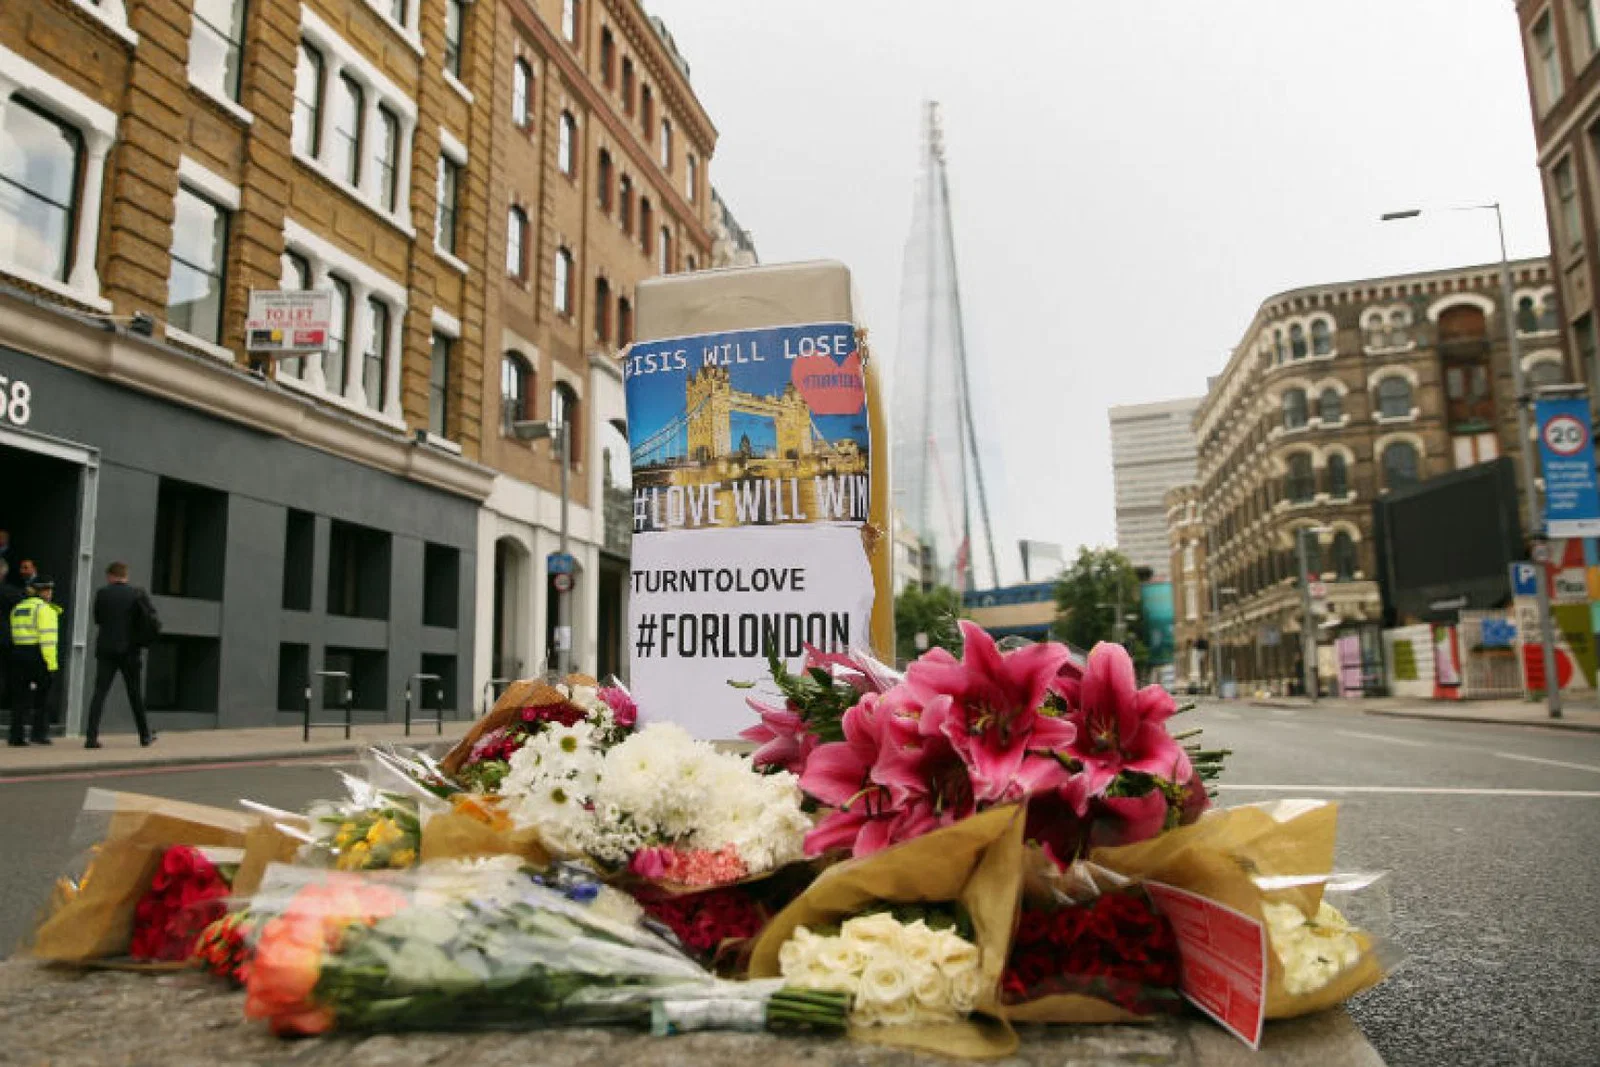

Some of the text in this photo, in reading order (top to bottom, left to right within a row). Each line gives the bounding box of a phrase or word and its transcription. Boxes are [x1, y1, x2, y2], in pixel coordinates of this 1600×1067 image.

[266, 307, 285, 320] TO
[704, 341, 765, 367] WILL
[784, 335, 848, 361] LOSE
[1549, 426, 1582, 444] 20
[633, 474, 868, 530] #LOVE WILL WIN
[632, 567, 806, 593] TURNTOLOVE
[635, 611, 850, 659] #FORLONDON
